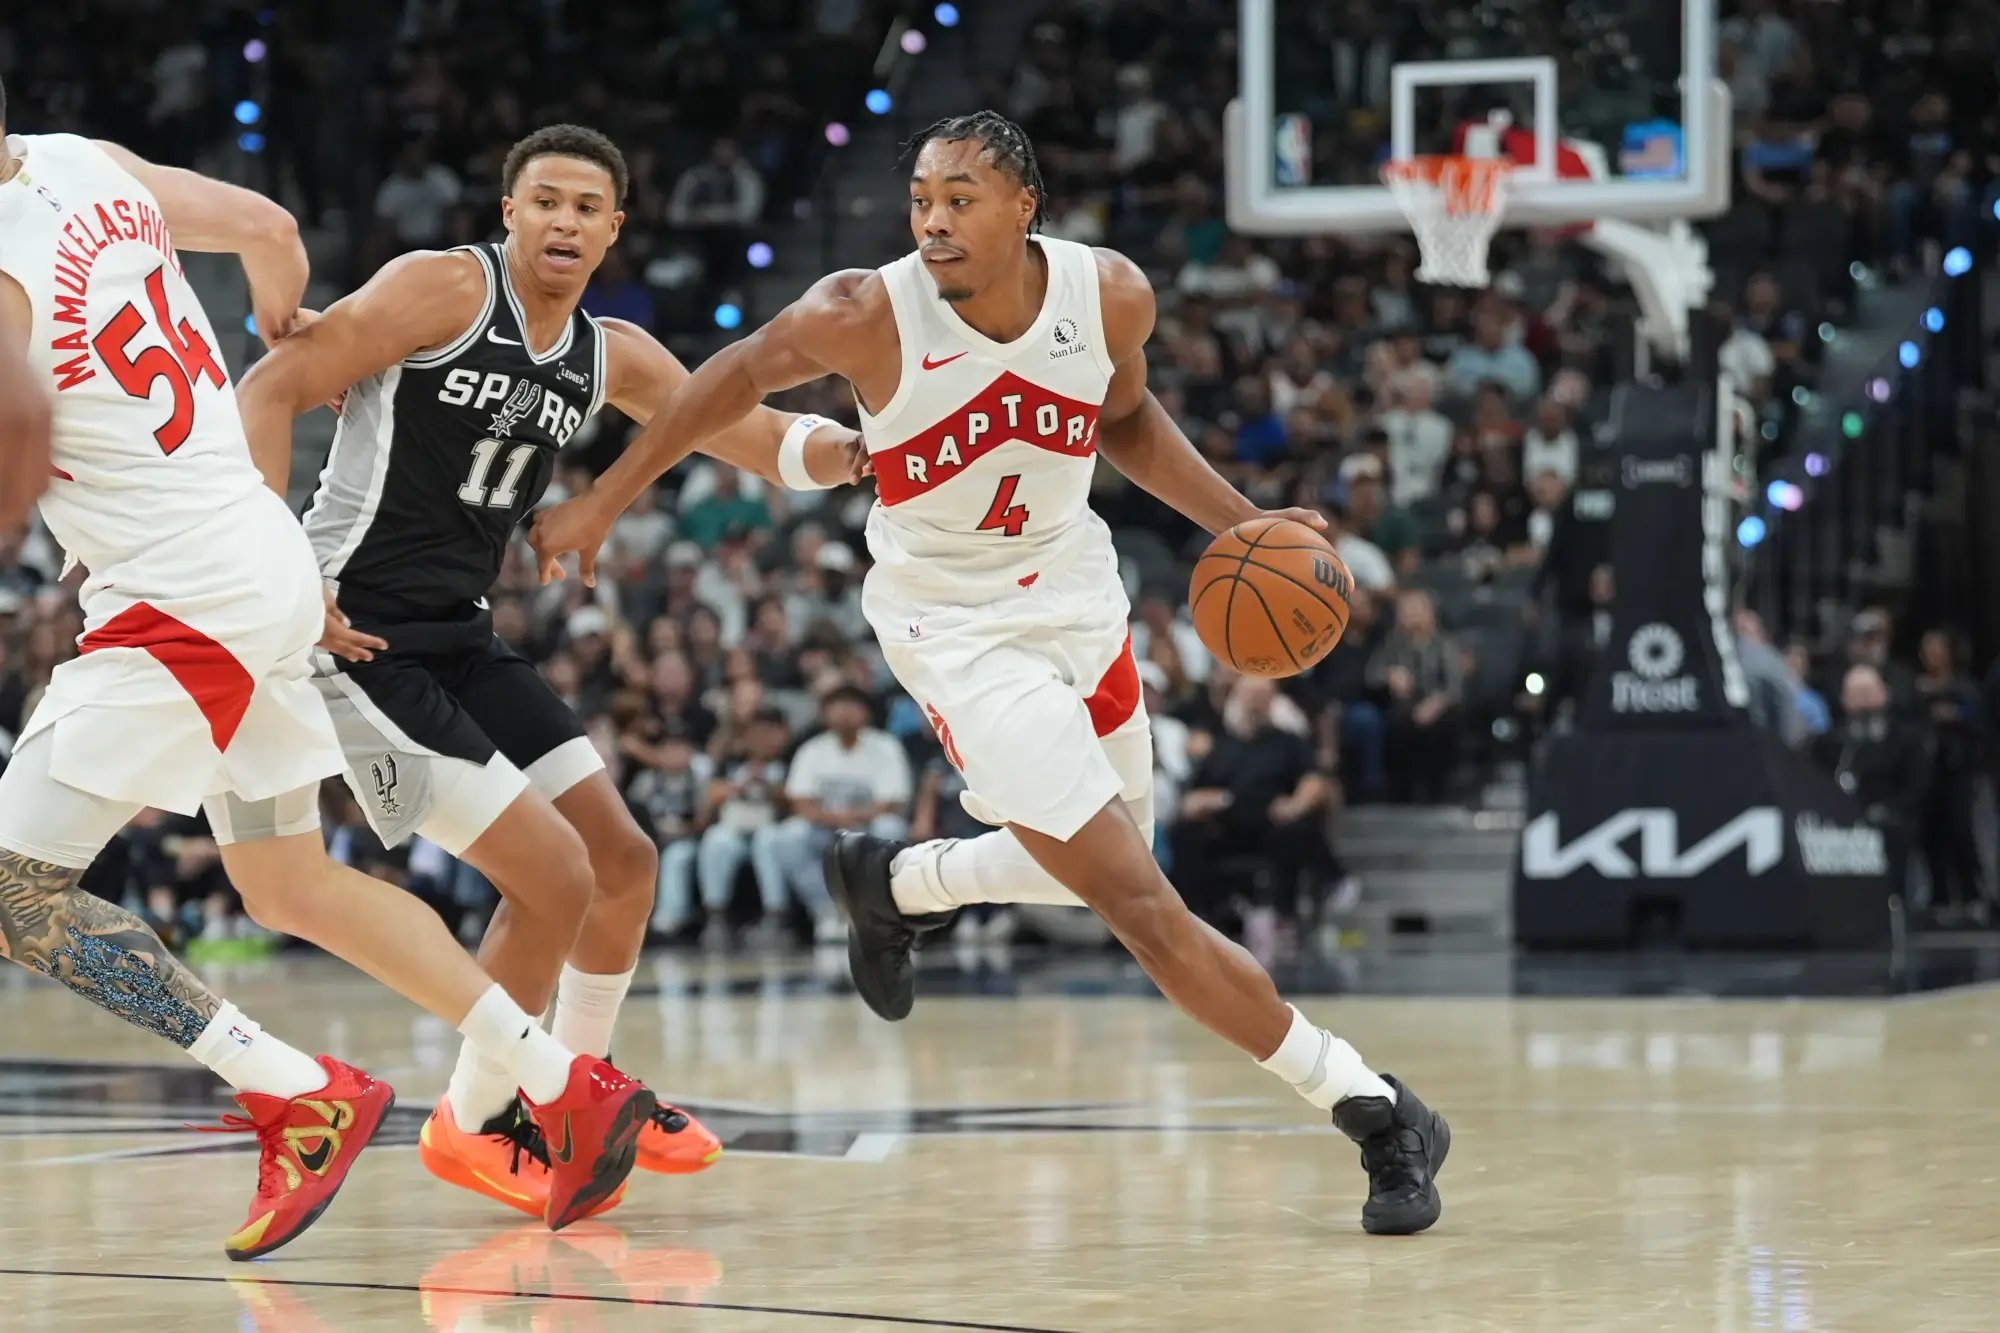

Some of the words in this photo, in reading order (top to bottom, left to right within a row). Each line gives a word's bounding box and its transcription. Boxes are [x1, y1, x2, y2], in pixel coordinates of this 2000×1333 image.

[92, 264, 227, 457] 54
[560, 367, 585, 386] LEDGER
[1049, 349, 1069, 360] Sun
[1069, 341, 1087, 355] Life
[437, 367, 582, 448] SPURS
[904, 393, 1097, 484] RAPTORS
[456, 437, 538, 509] 11
[975, 473, 1030, 537] 4
[1522, 807, 1784, 878] KIA
